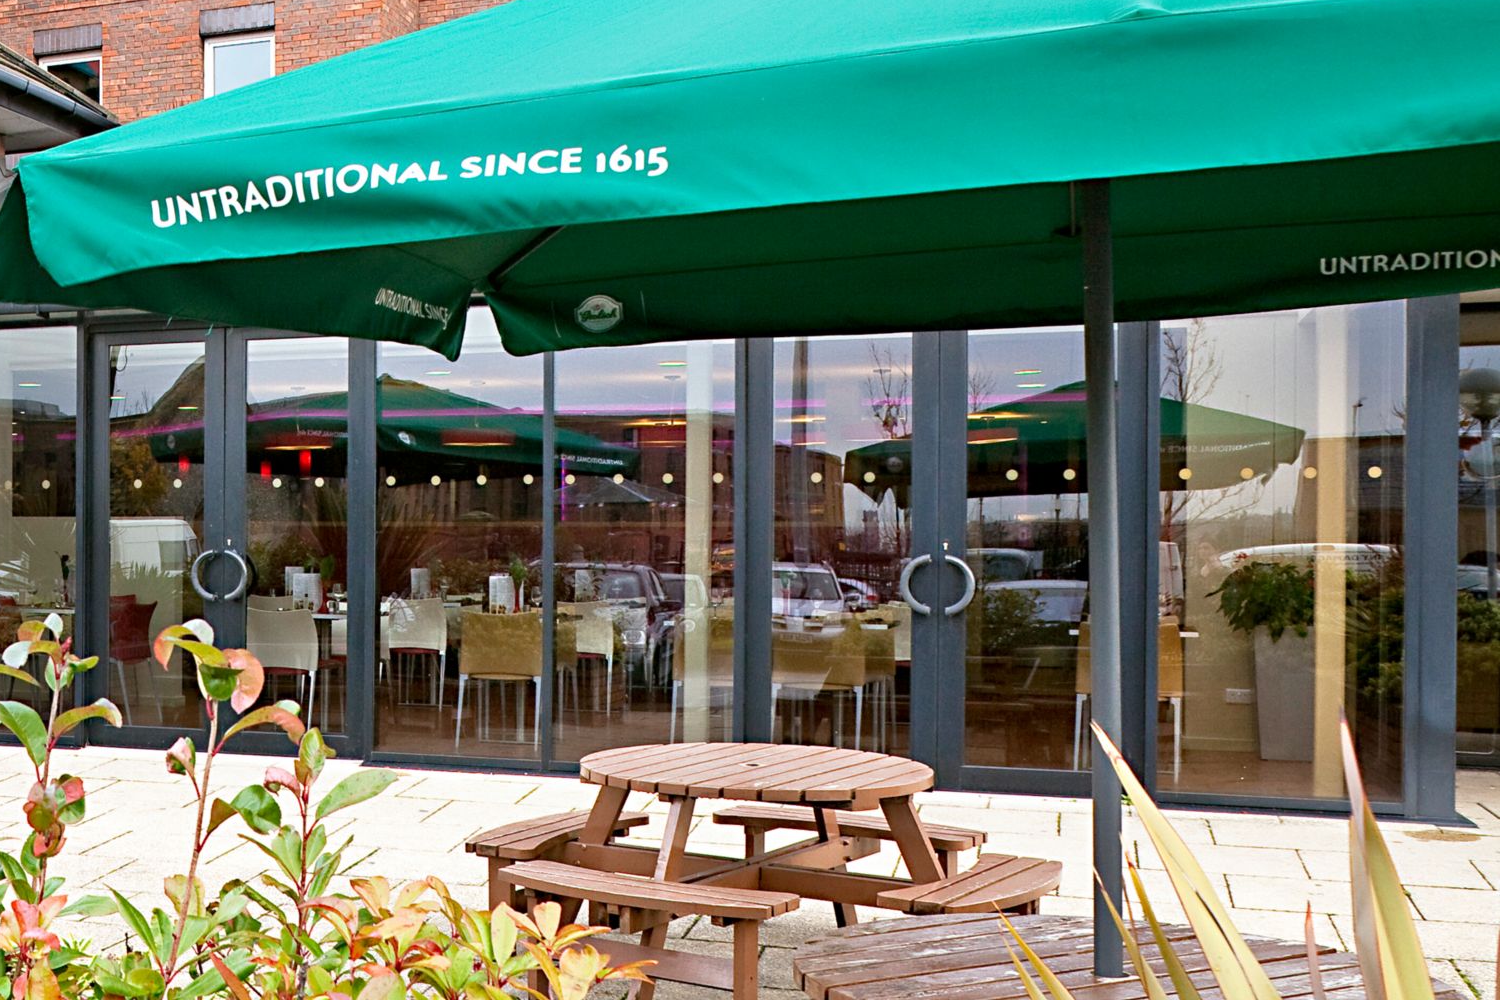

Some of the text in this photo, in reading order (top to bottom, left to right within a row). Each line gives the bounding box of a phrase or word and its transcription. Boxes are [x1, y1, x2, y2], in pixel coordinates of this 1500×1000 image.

[151, 144, 669, 229] UNTRADITIONAL SINCE 1615
[374, 287, 425, 318] UNTRADITIONAL
